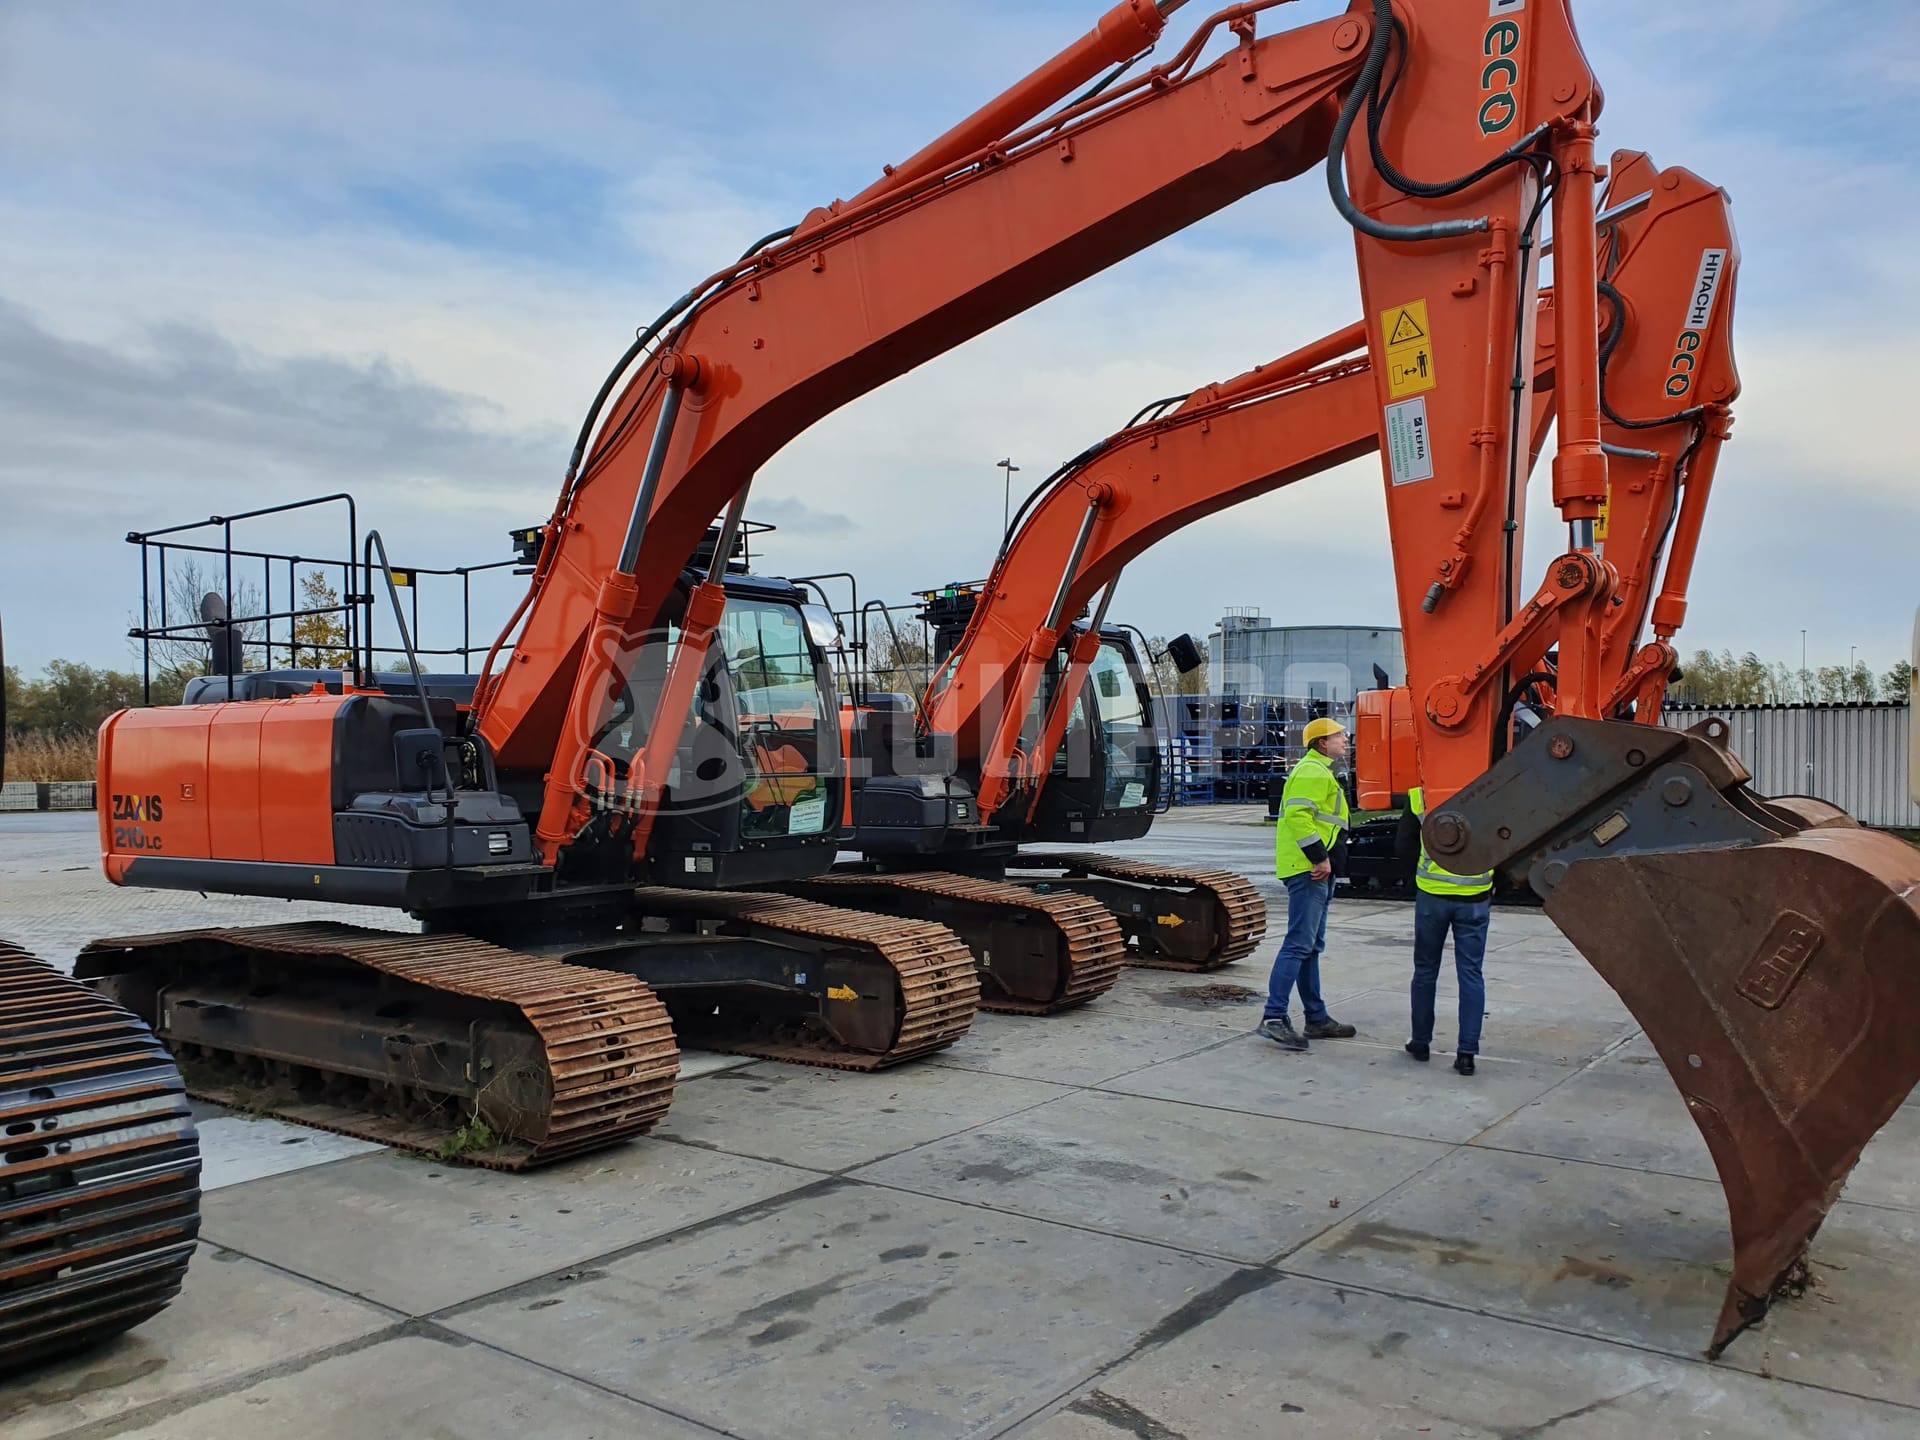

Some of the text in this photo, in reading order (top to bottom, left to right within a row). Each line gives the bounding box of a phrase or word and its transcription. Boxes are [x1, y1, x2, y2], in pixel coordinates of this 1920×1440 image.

[1691, 254, 1720, 324] HITACHI
[1414, 427, 1425, 459] TEFRA
[112, 794, 163, 822] ZAXIS
